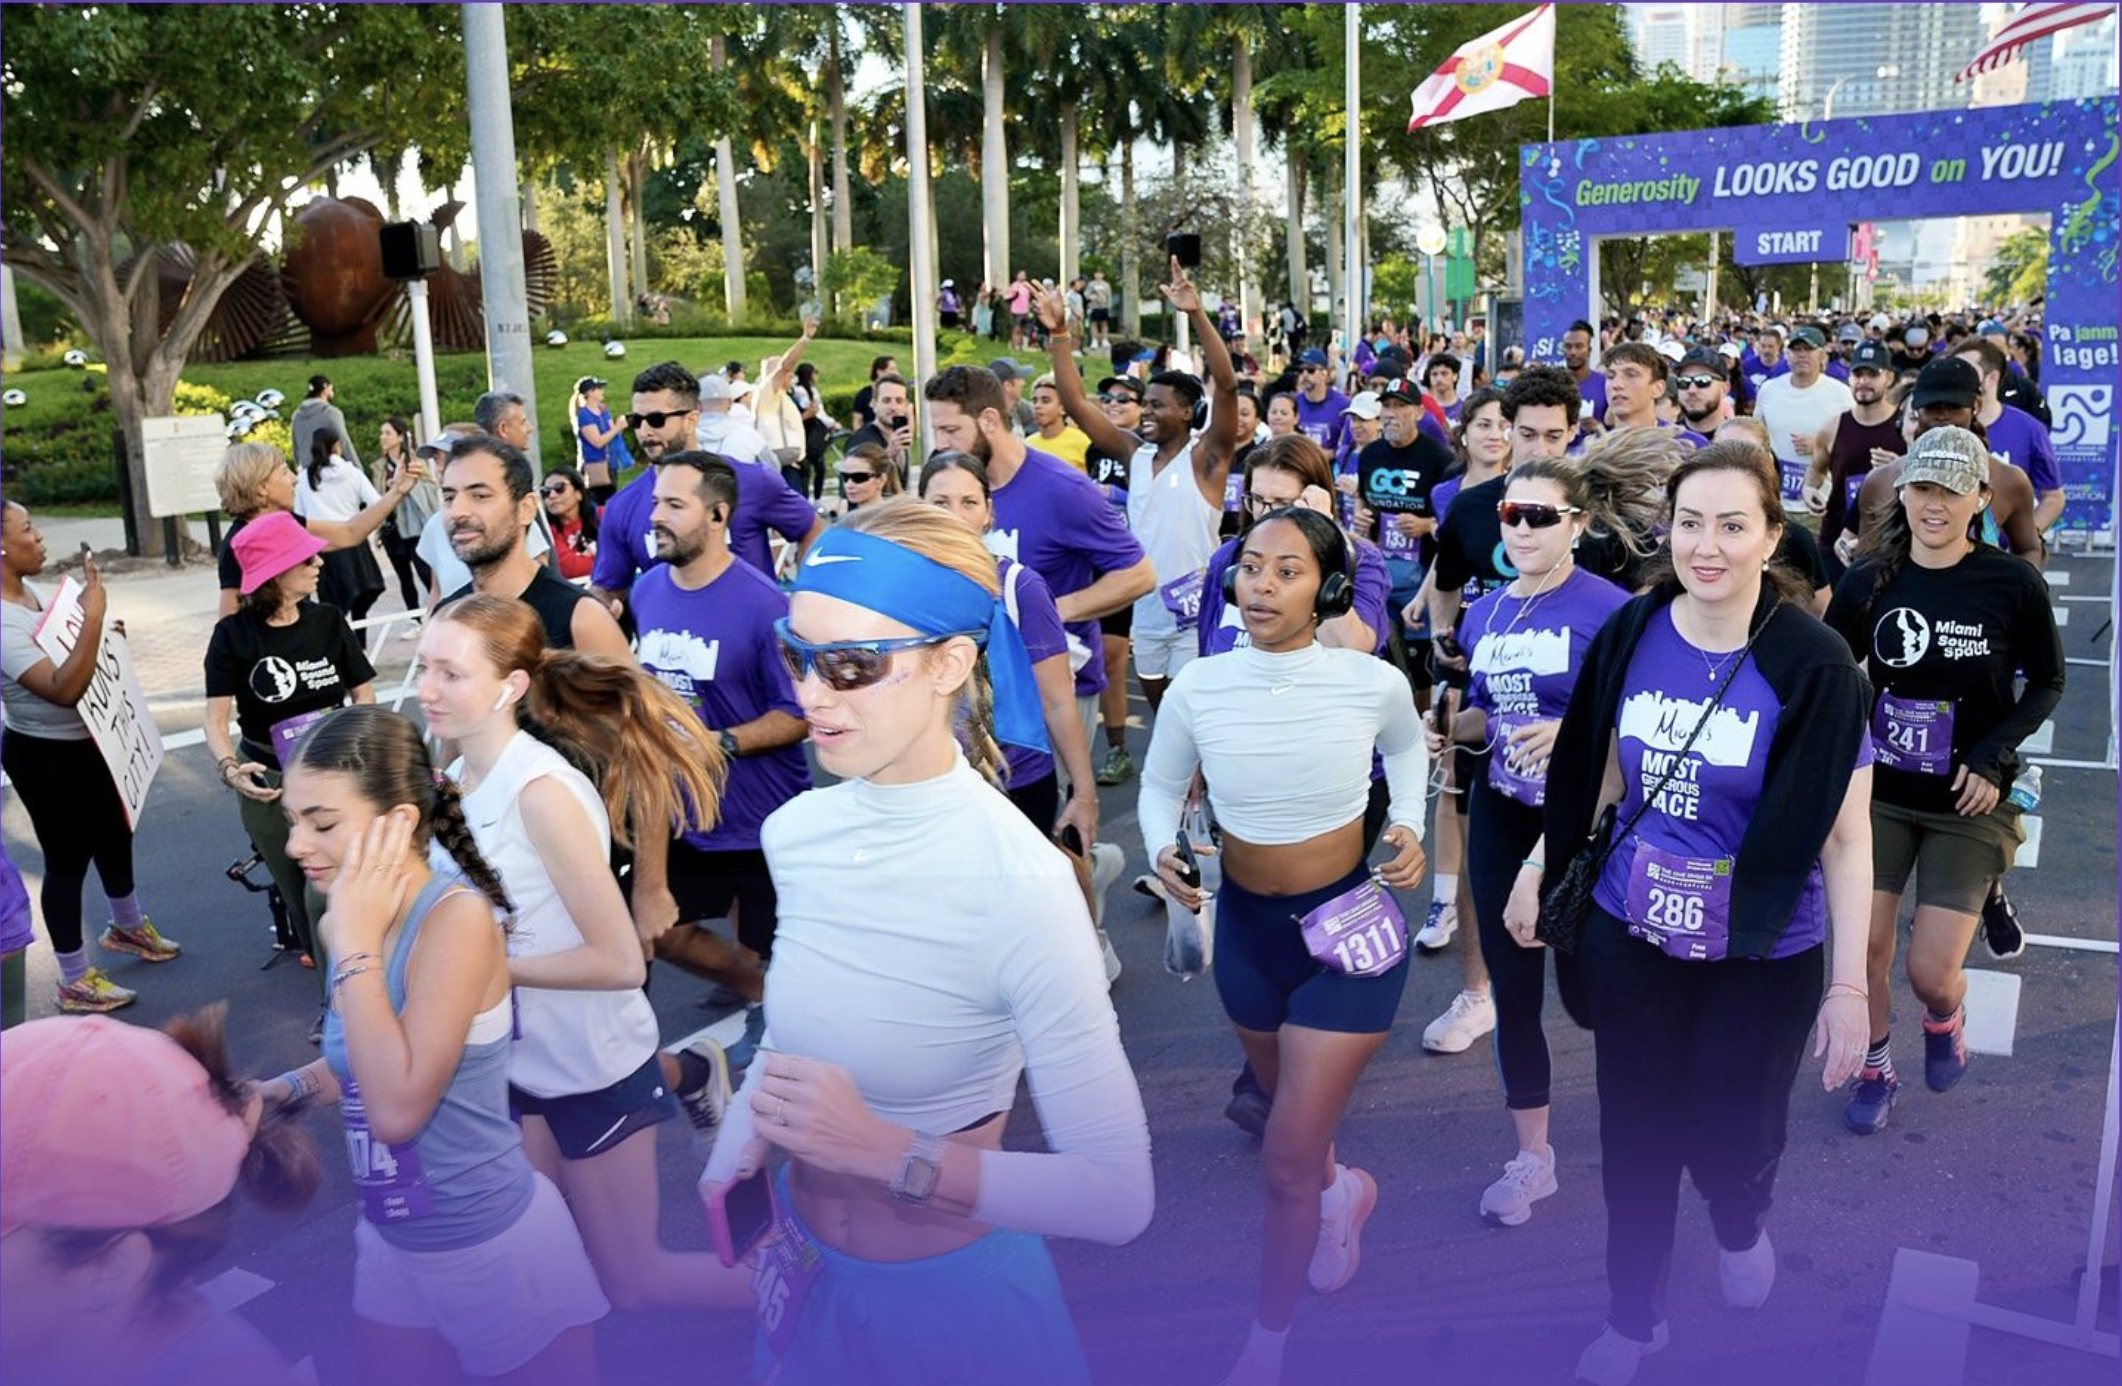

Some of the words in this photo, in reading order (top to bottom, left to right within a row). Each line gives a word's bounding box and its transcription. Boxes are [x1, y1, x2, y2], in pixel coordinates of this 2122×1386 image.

[1576, 173, 1700, 206] Generosity
[1713, 159, 1818, 198] LOOKS
[1826, 153, 1920, 191] GOOD
[1931, 159, 1965, 184] on
[1981, 142, 2065, 180] YOU!
[1757, 230, 1823, 256] START
[2049, 324, 2071, 341] Pa
[2074, 325, 2118, 342] janm
[2053, 343, 2119, 370] lage!
[1370, 467, 1421, 496] GCF
[1935, 620, 1983, 637] Miami
[1938, 635, 1989, 650] Sound
[1486, 673, 1533, 694] MOST
[1887, 720, 1928, 752] 241
[124, 723, 154, 811] CITY!
[1642, 749, 1702, 782] MOST
[1647, 887, 1705, 931] 286
[1333, 916, 1400, 973] 1311
